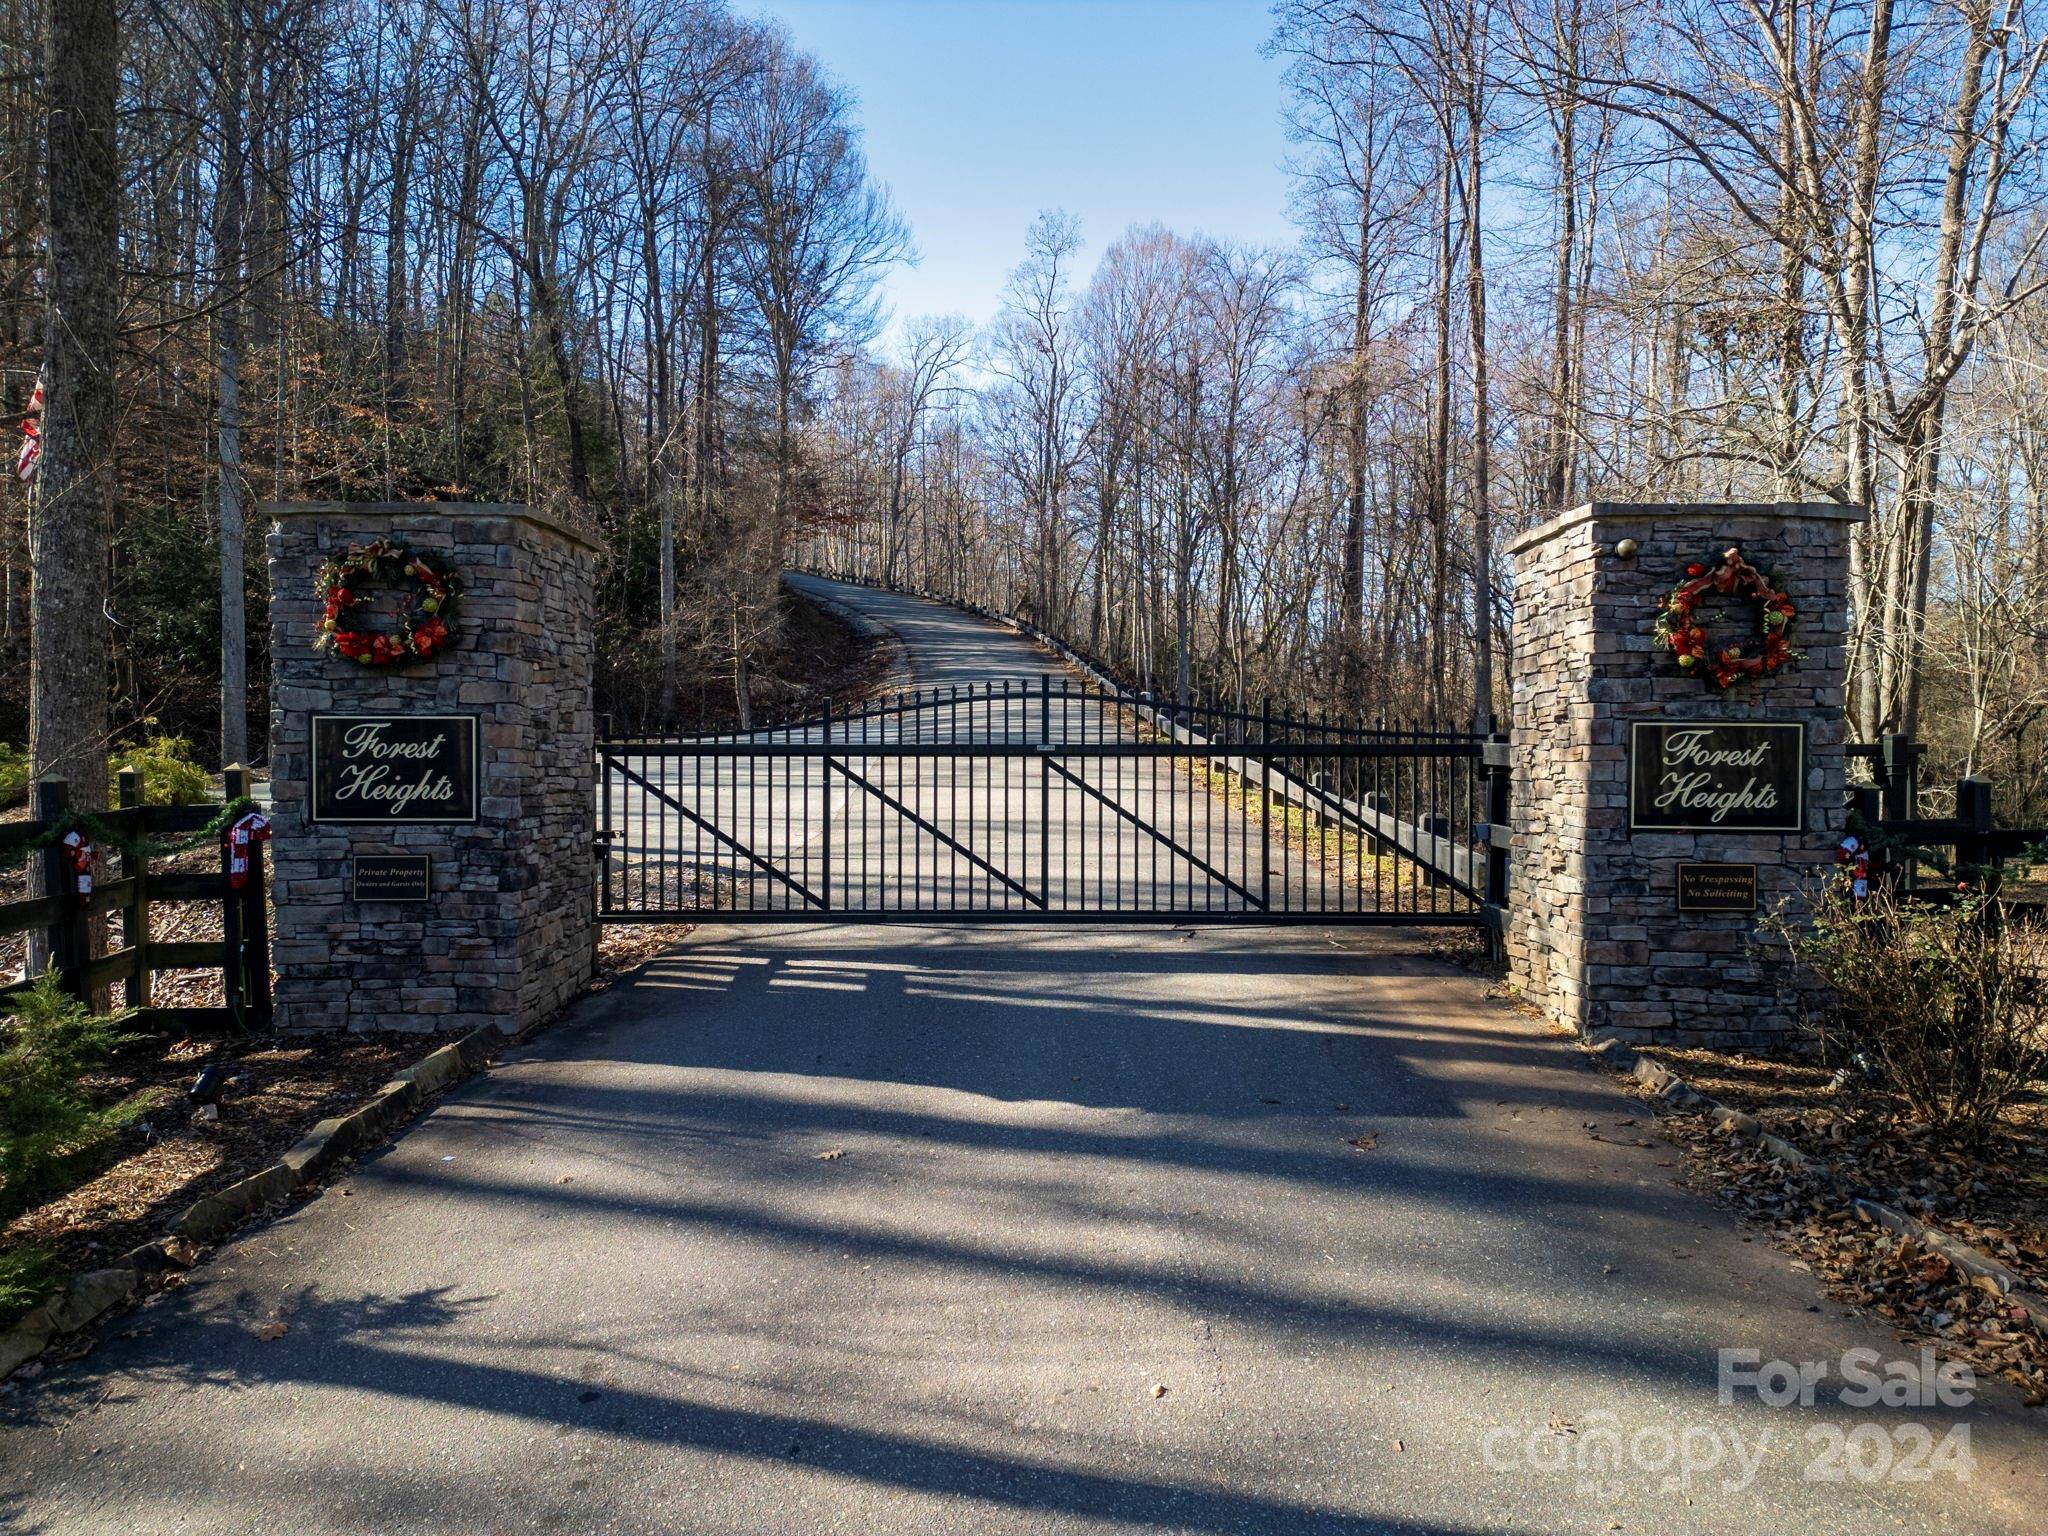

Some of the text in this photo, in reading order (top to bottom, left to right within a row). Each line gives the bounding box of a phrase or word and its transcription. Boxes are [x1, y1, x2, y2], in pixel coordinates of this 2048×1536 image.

[343, 723, 446, 759] Forest
[1662, 729, 1771, 766] Forest
[335, 764, 453, 815] Heights
[1654, 772, 1777, 823] Heights
[358, 868, 425, 878] Private Property
[1682, 874, 1753, 885] No Trespassing
[1687, 888, 1749, 899] No Soliciting
